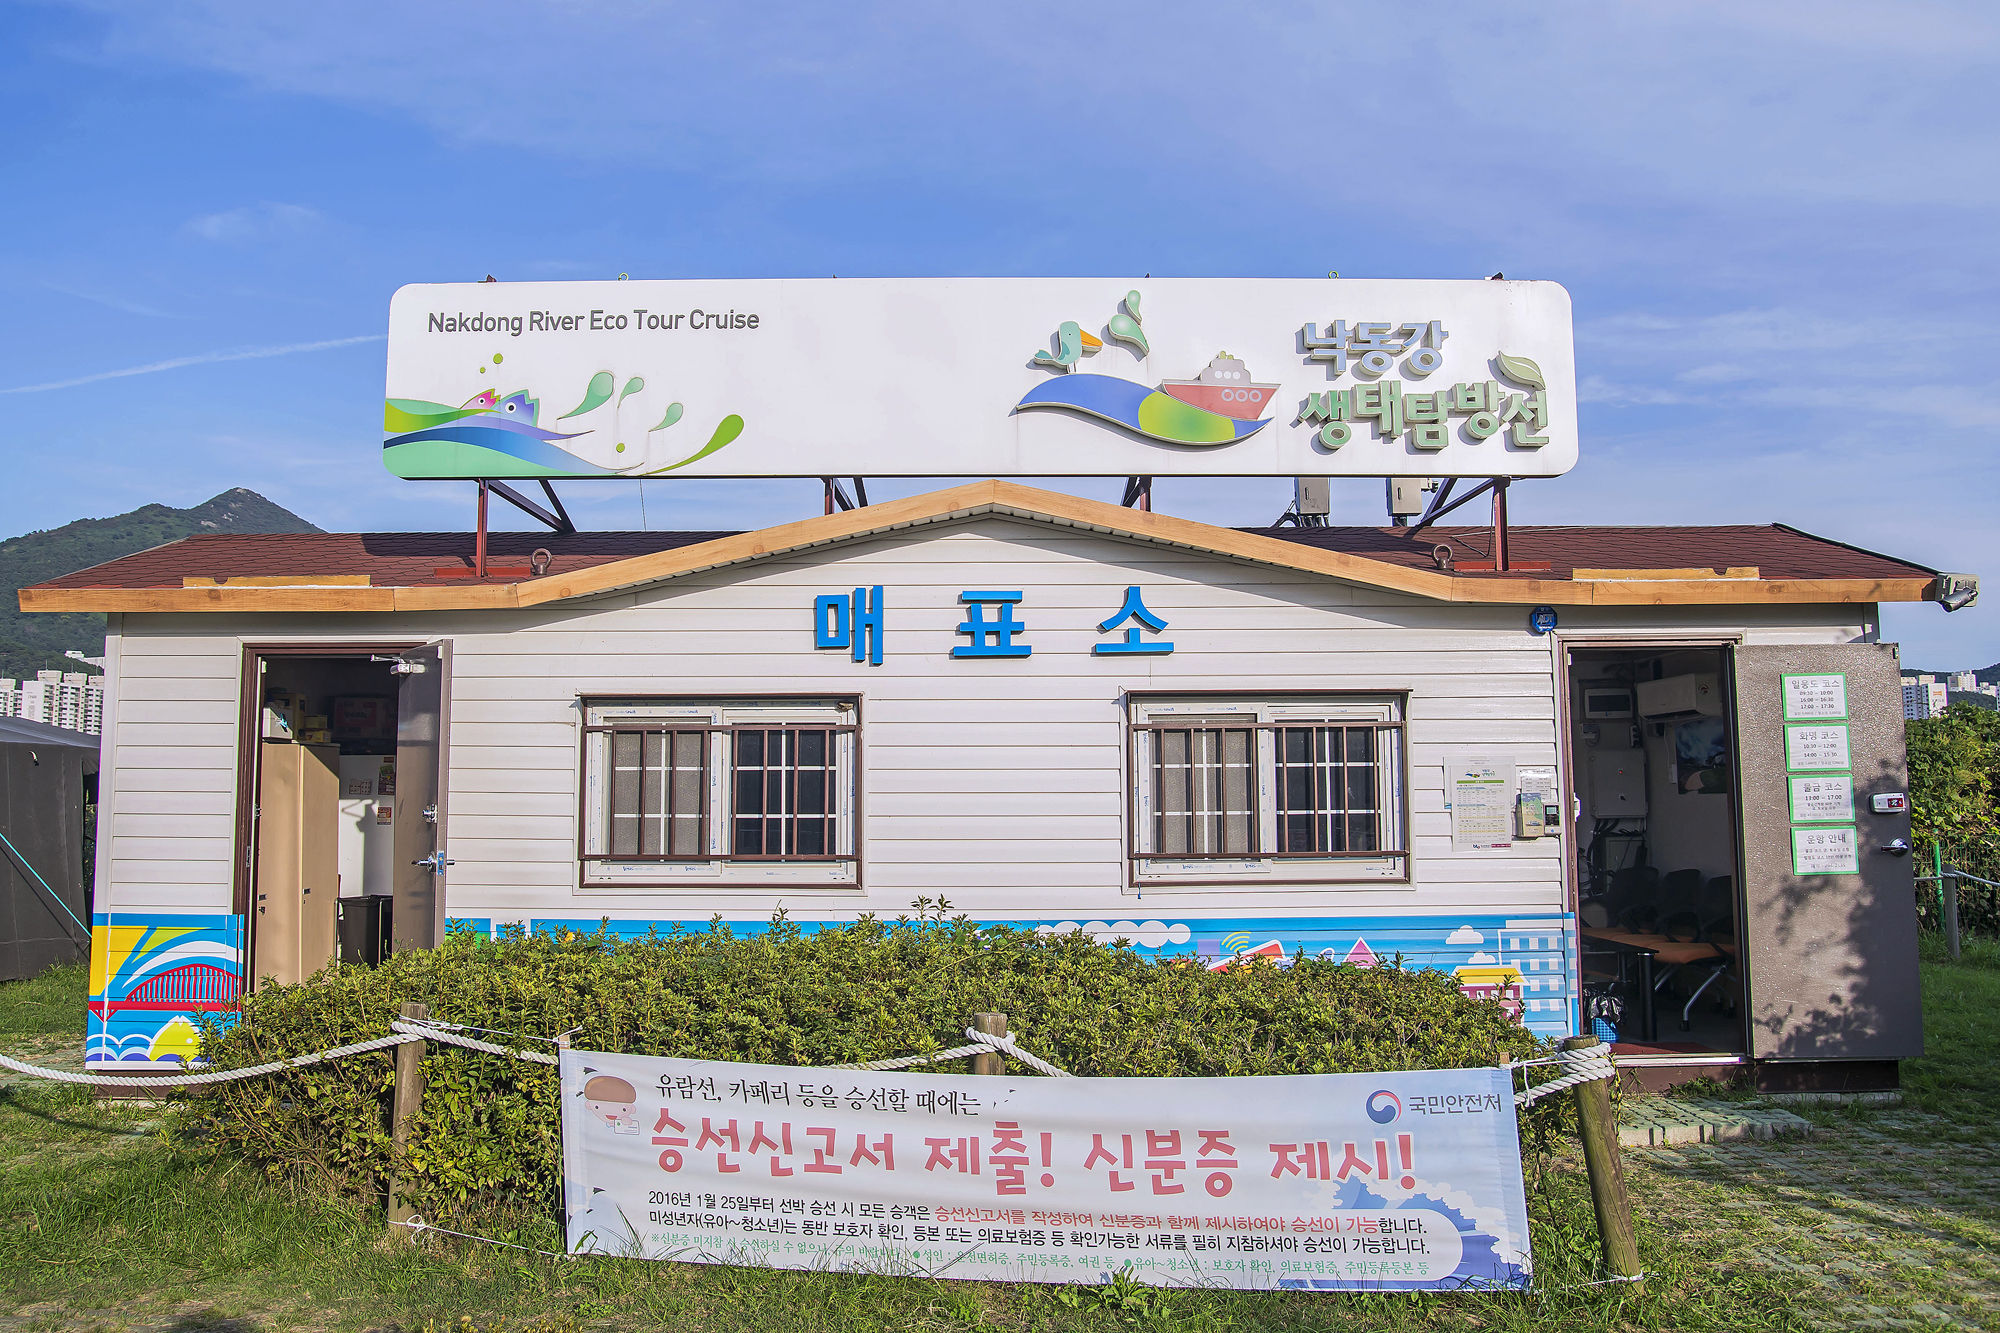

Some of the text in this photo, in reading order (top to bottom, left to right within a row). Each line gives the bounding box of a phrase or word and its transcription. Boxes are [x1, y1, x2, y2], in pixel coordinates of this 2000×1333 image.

[428, 308, 760, 336] Nakdong River Eco Tour Cruise
[1303, 319, 1449, 376] 낙동강
[1298, 379, 1550, 450] 생태탐방선
[1822, 679, 1840, 688] 코스
[1821, 731, 1839, 740] 코스
[1824, 782, 1843, 791] 코스
[1828, 833, 1847, 844] 안내
[655, 1075, 981, 1117] 유람선, 카페리 등을 승선할 때에는
[1409, 1093, 1502, 1115] 국민안전처
[651, 1107, 1417, 1198] 승선신고서 제출! 신분증 제시!
[648, 1190, 1428, 1234] 2016년 1월 25일부터 선박 승선 시 모든 승객은 승선신고서를 작성하여 신분증과 함께 제시하여야 승선이 가능합니다.
[649, 1210, 1431, 1255] 미성년자(유아~청소년)는 동반 보호자 확인, 등본 또는 의료보험증 등 확인가능한 서류를 필히 지참하셔야 승선이 가능합니다.
[693, 1233, 724, 1249] 미지참
[739, 1238, 780, 1253] 승선하실
[783, 1241, 794, 1254] 수
[1016, 1252, 1074, 1268] 주민등록증,
[1078, 1254, 1101, 1269] 여권
[1103, 1256, 1116, 1270] 등
[1212, 1258, 1246, 1273] 보호자
[1249, 1258, 1276, 1274] 확인,
[1280, 1259, 1340, 1275] 의료보험증,
[1344, 1260, 1415, 1276] 주민등록등본
[1417, 1261, 1430, 1276] 등
